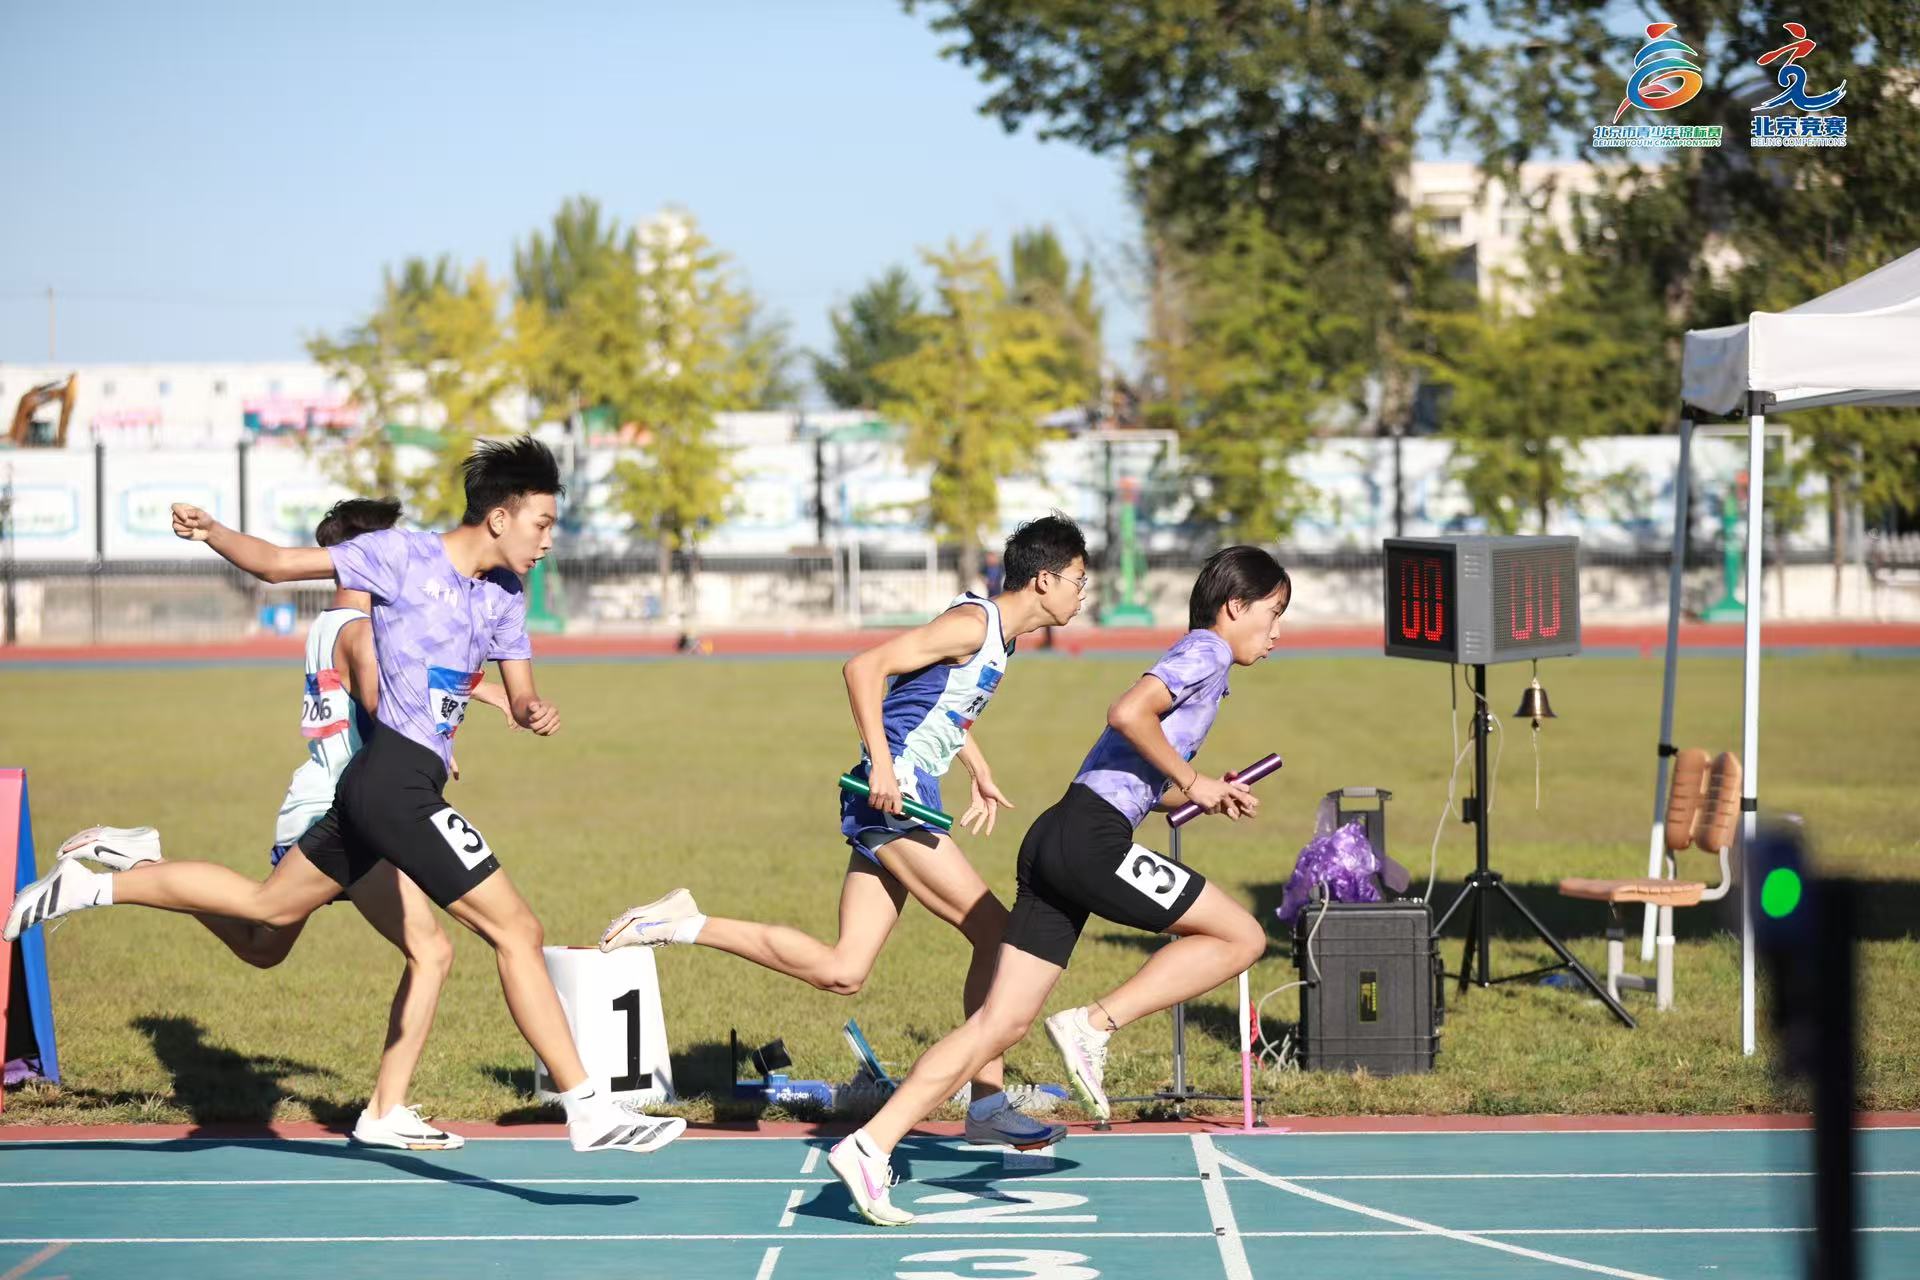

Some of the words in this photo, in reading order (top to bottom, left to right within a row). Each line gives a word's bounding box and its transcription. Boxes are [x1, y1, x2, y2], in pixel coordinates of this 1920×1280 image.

[1401, 559, 1443, 642] 00
[1511, 560, 1562, 641] 00
[447, 813, 484, 854] 3
[1132, 855, 1176, 895] 3
[610, 988, 653, 1093] 1
[912, 1190, 1098, 1224] 2
[895, 1248, 1102, 1280] 3
